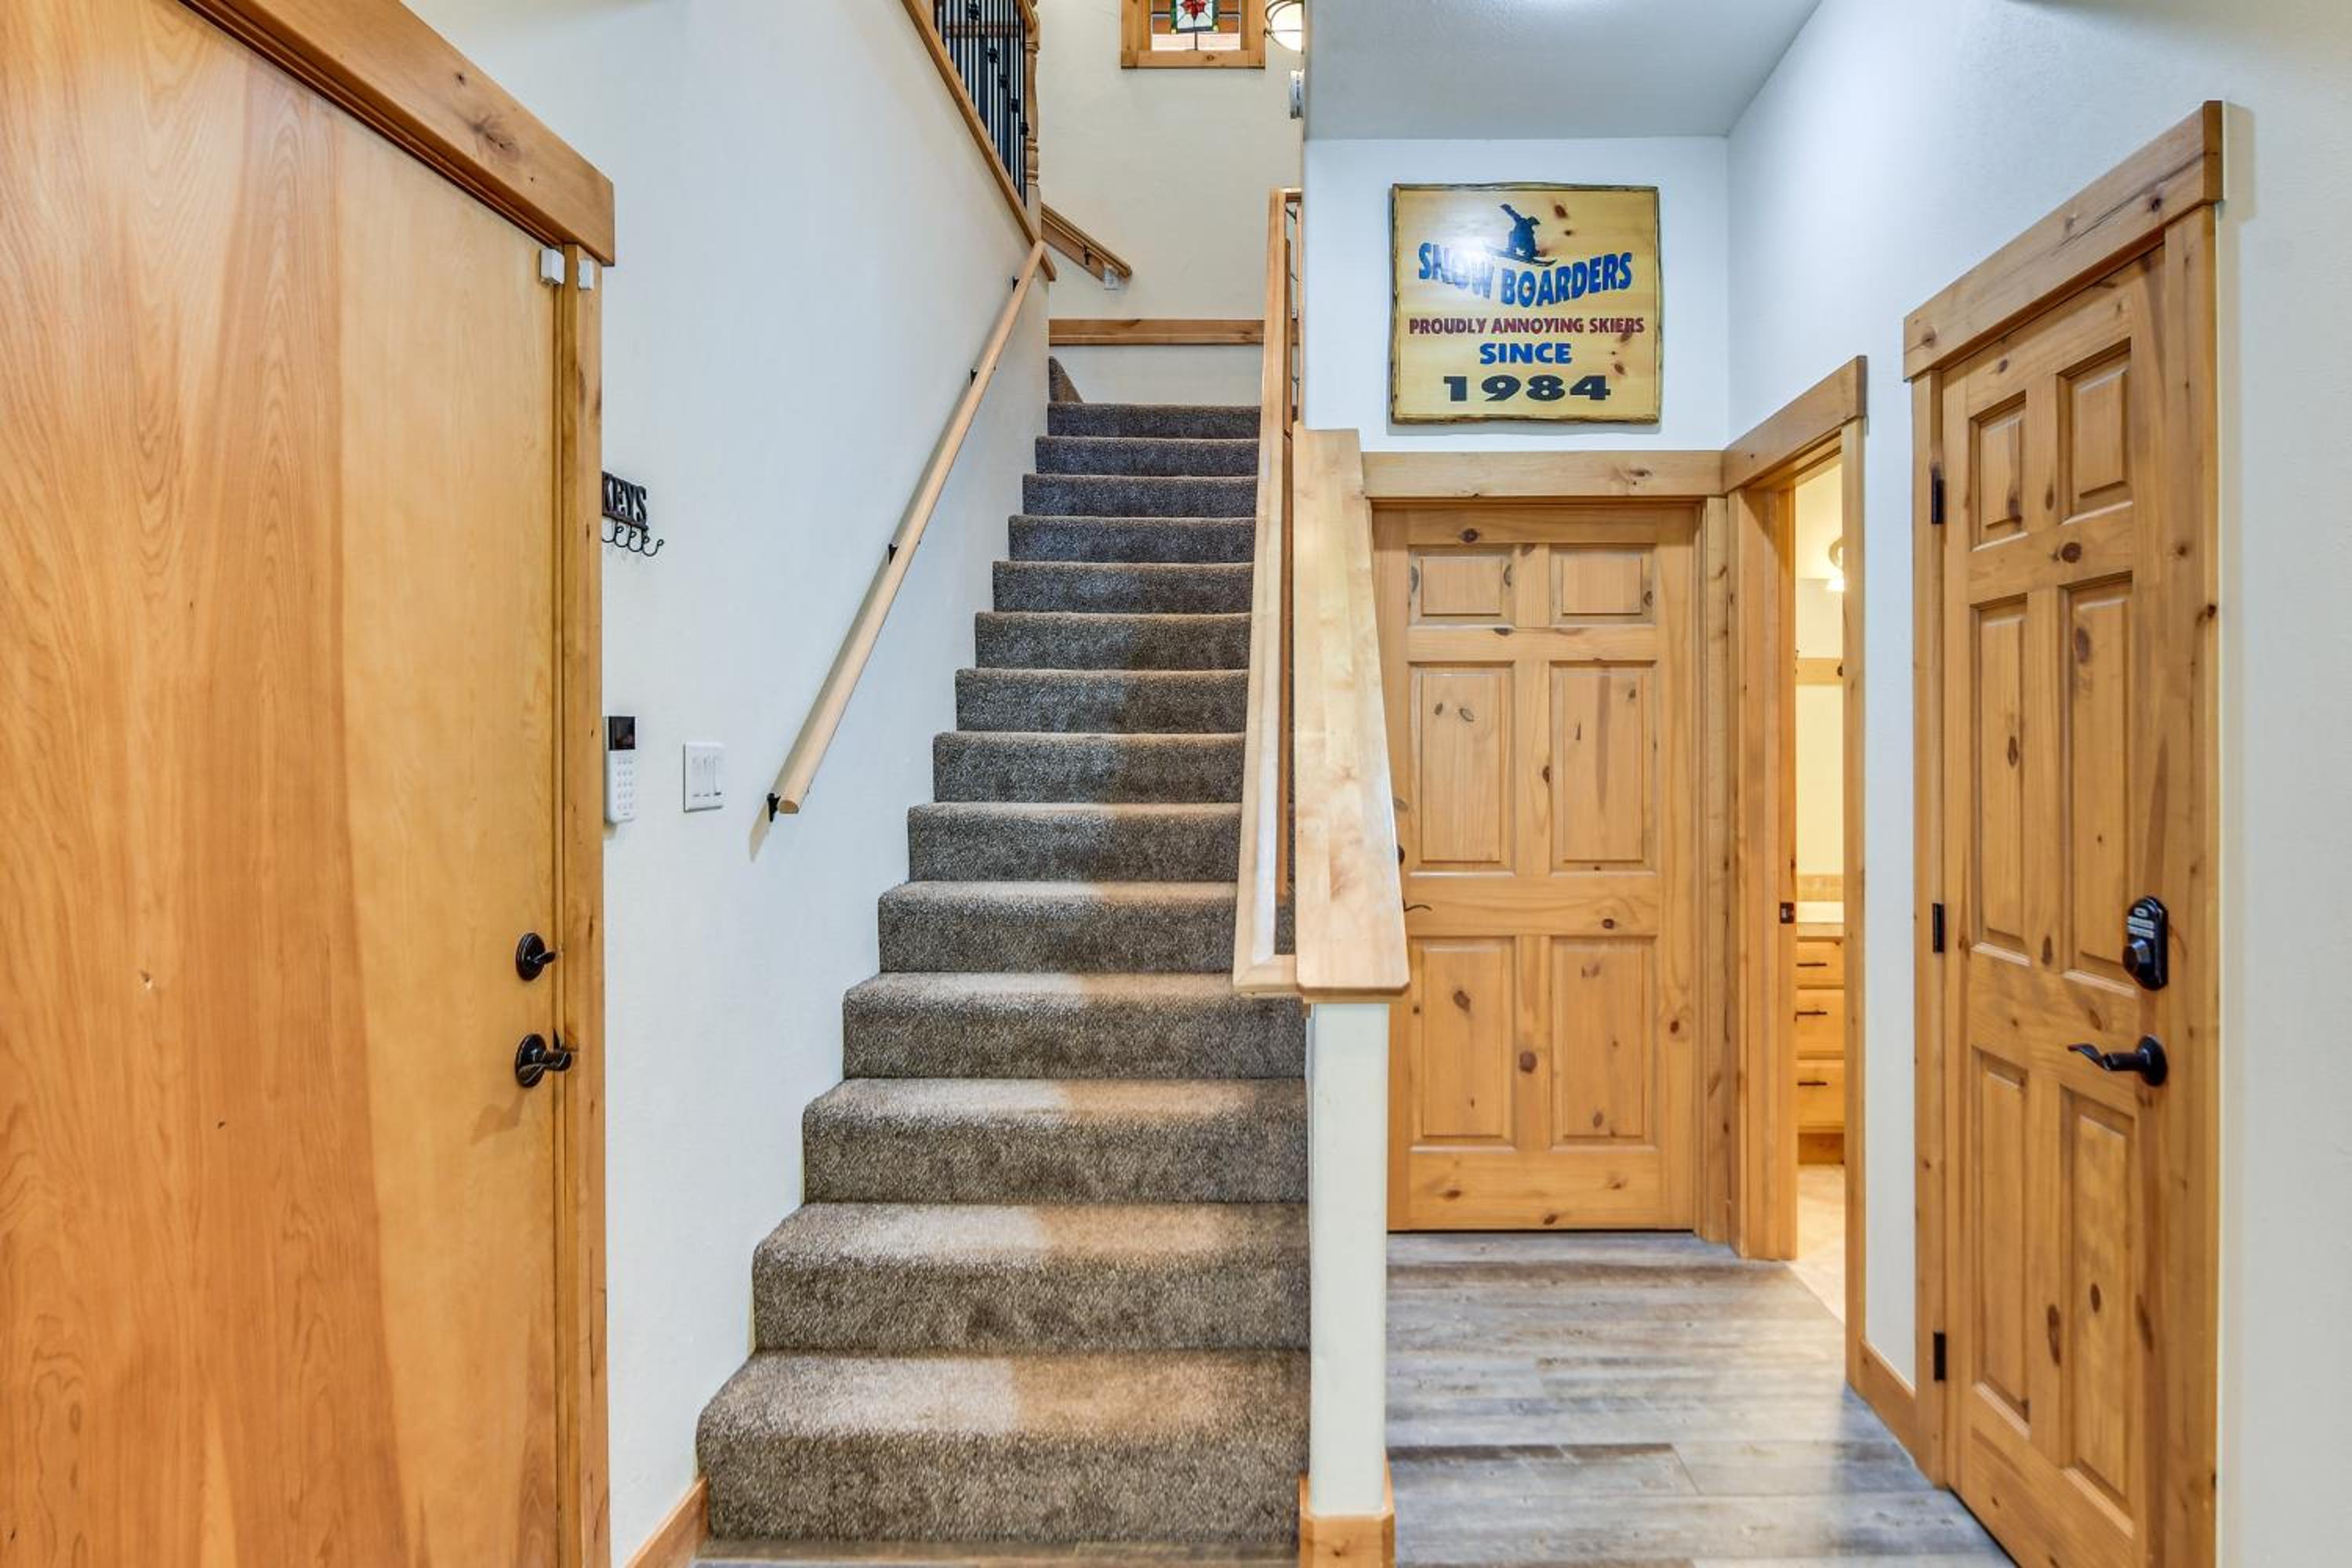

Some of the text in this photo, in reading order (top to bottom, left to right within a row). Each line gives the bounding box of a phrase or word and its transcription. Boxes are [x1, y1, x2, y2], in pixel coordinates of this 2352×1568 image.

[1500, 252, 1632, 307] BOARDERS
[1409, 318, 1645, 335] PROUDLY ANNOYING SKIERS
[1479, 343, 1573, 365] SINCE
[1443, 375, 1611, 402] 1984
